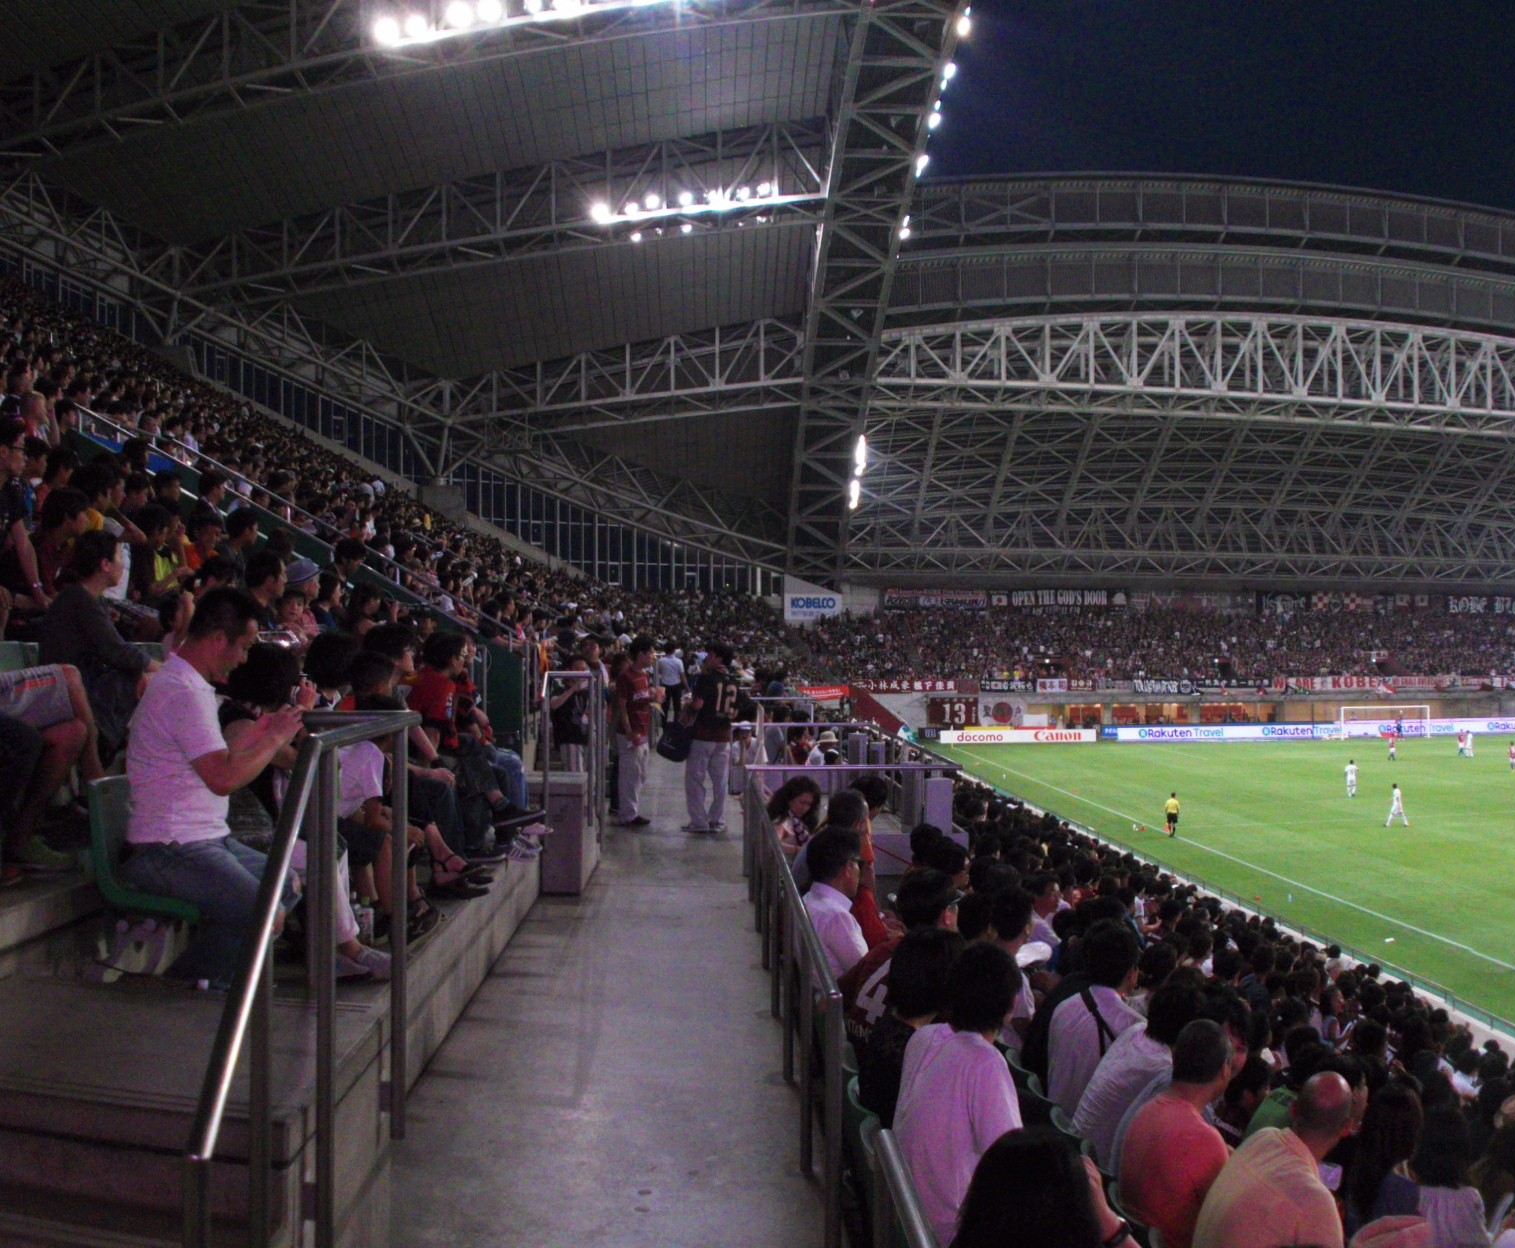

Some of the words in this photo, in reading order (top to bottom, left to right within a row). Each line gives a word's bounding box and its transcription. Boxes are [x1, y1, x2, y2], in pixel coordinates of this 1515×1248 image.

[790, 597, 836, 609] KOBELCO
[1012, 590, 1035, 606] OPEN
[1037, 590, 1056, 605] THE
[1084, 590, 1108, 605] DOOR
[1331, 676, 1378, 689] KOBE
[716, 682, 739, 719] 12
[943, 703, 966, 724] 13
[1033, 730, 1082, 742] Canon
[1148, 727, 1192, 738] Rakuten
[1194, 727, 1224, 738] Travel
[1271, 726, 1313, 736] Rakuten
[1314, 725, 1342, 735] Travel
[957, 732, 1004, 742] docomo
[856, 957, 893, 1025] 4
